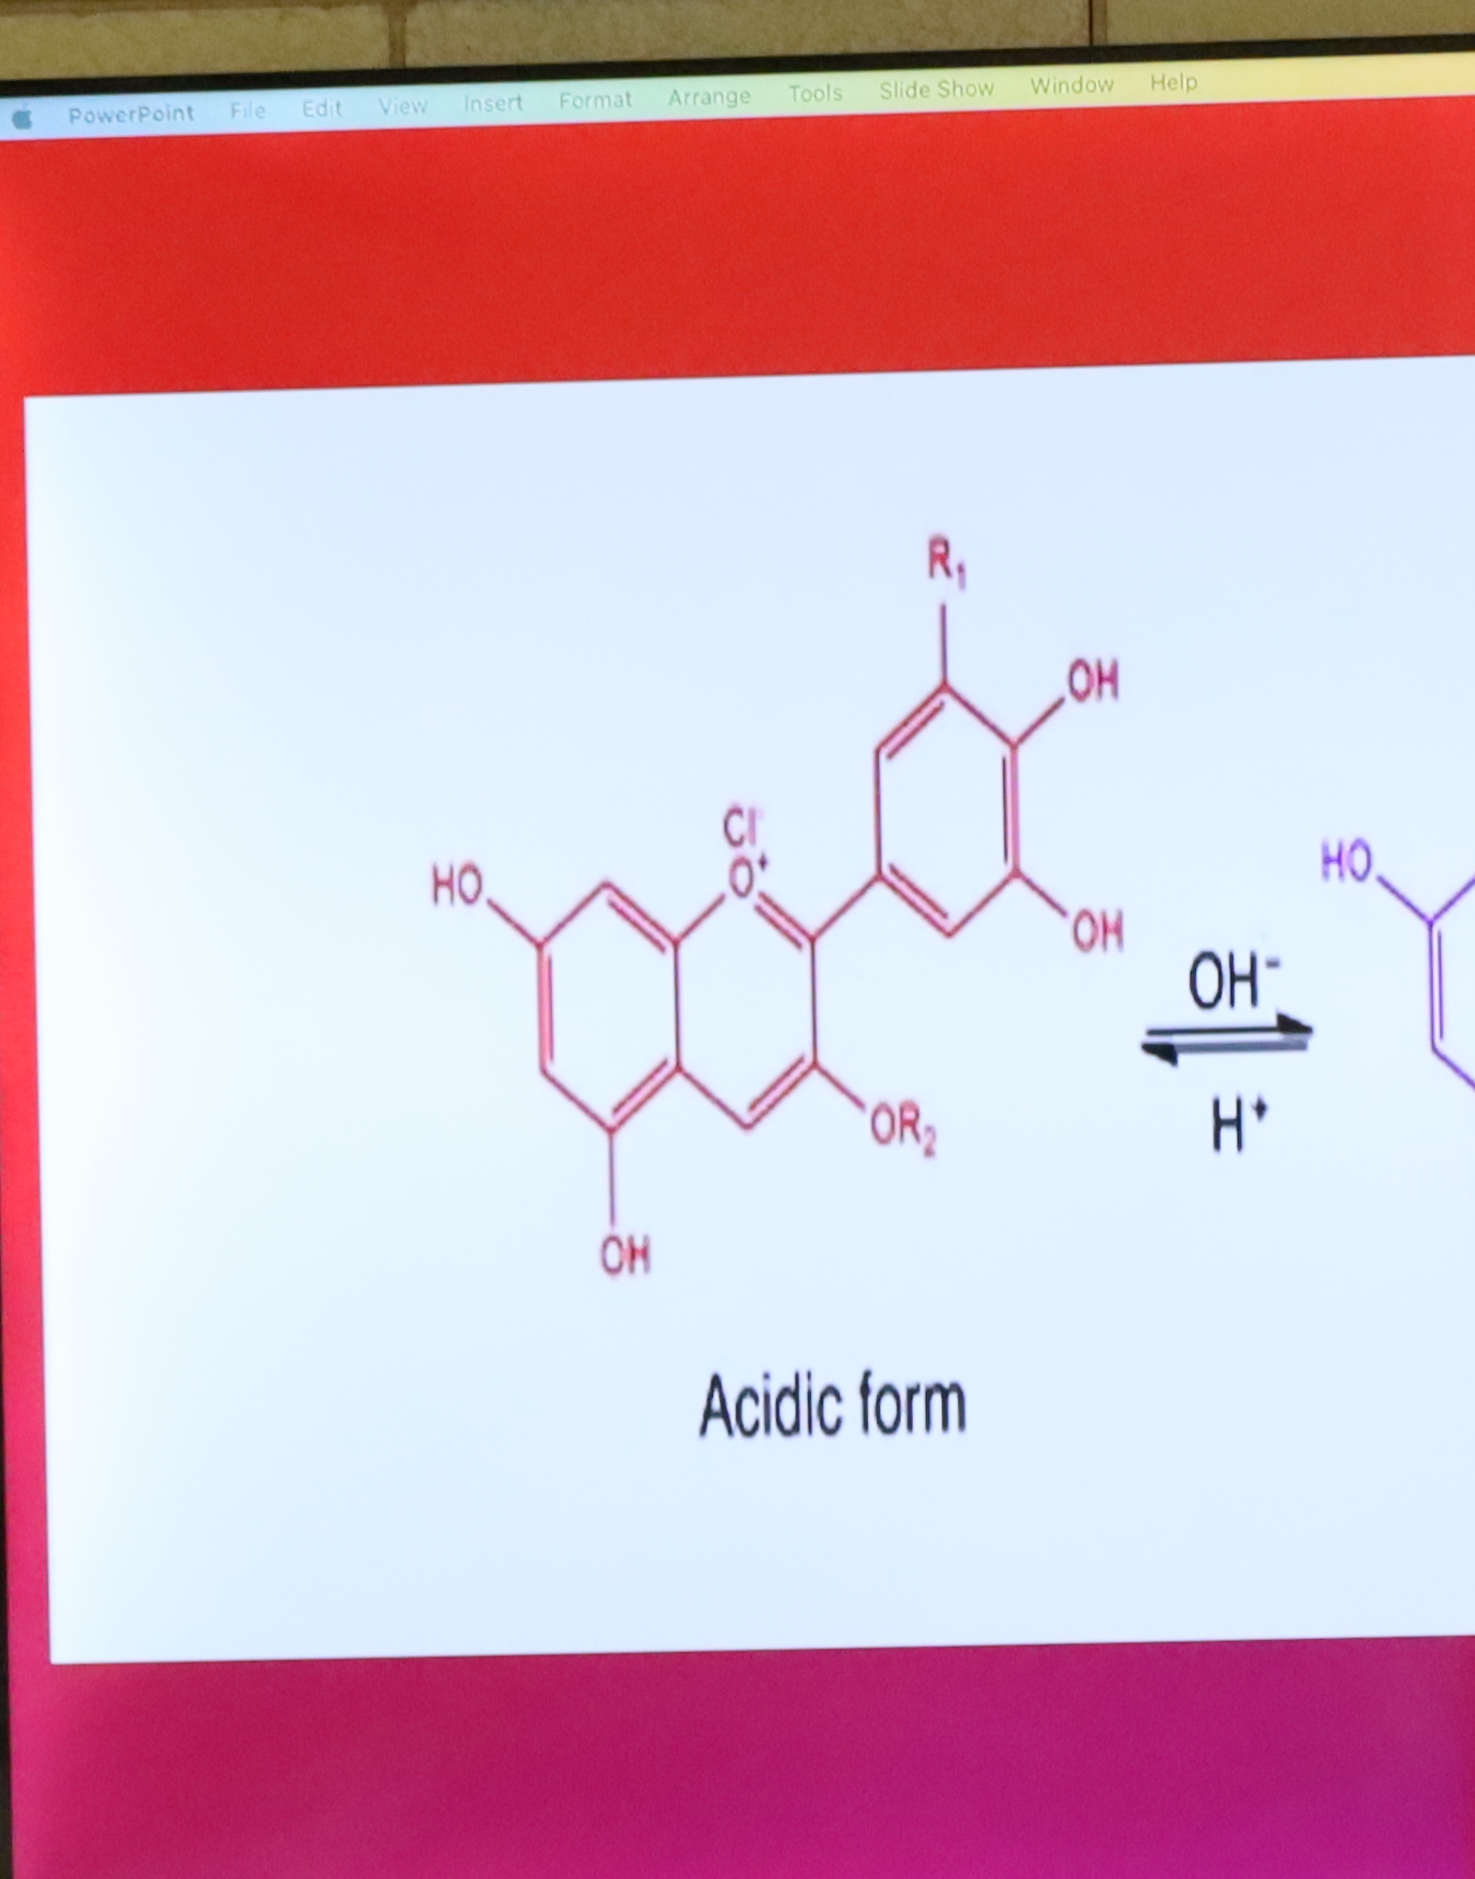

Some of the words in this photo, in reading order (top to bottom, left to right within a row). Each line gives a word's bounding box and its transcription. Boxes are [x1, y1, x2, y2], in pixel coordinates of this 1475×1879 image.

[68, 102, 195, 126] PowerPoint
[229, 99, 266, 120] File
[302, 97, 342, 118] Edit
[378, 94, 428, 116] View
[464, 92, 524, 114] Insert
[559, 88, 633, 111] Format
[667, 84, 752, 111] Arrange
[788, 83, 843, 104] Tools
[879, 79, 931, 100] Slide
[937, 77, 996, 99] Show
[1030, 74, 1115, 96] Window
[1151, 72, 1198, 96] Help
[1067, 658, 1118, 704] OH
[1321, 838, 1373, 883] HO
[432, 863, 483, 905] HO
[1072, 908, 1124, 953] OH
[600, 1235, 651, 1278] OH
[699, 1371, 846, 1439] Acidic
[860, 1370, 967, 1434] form
